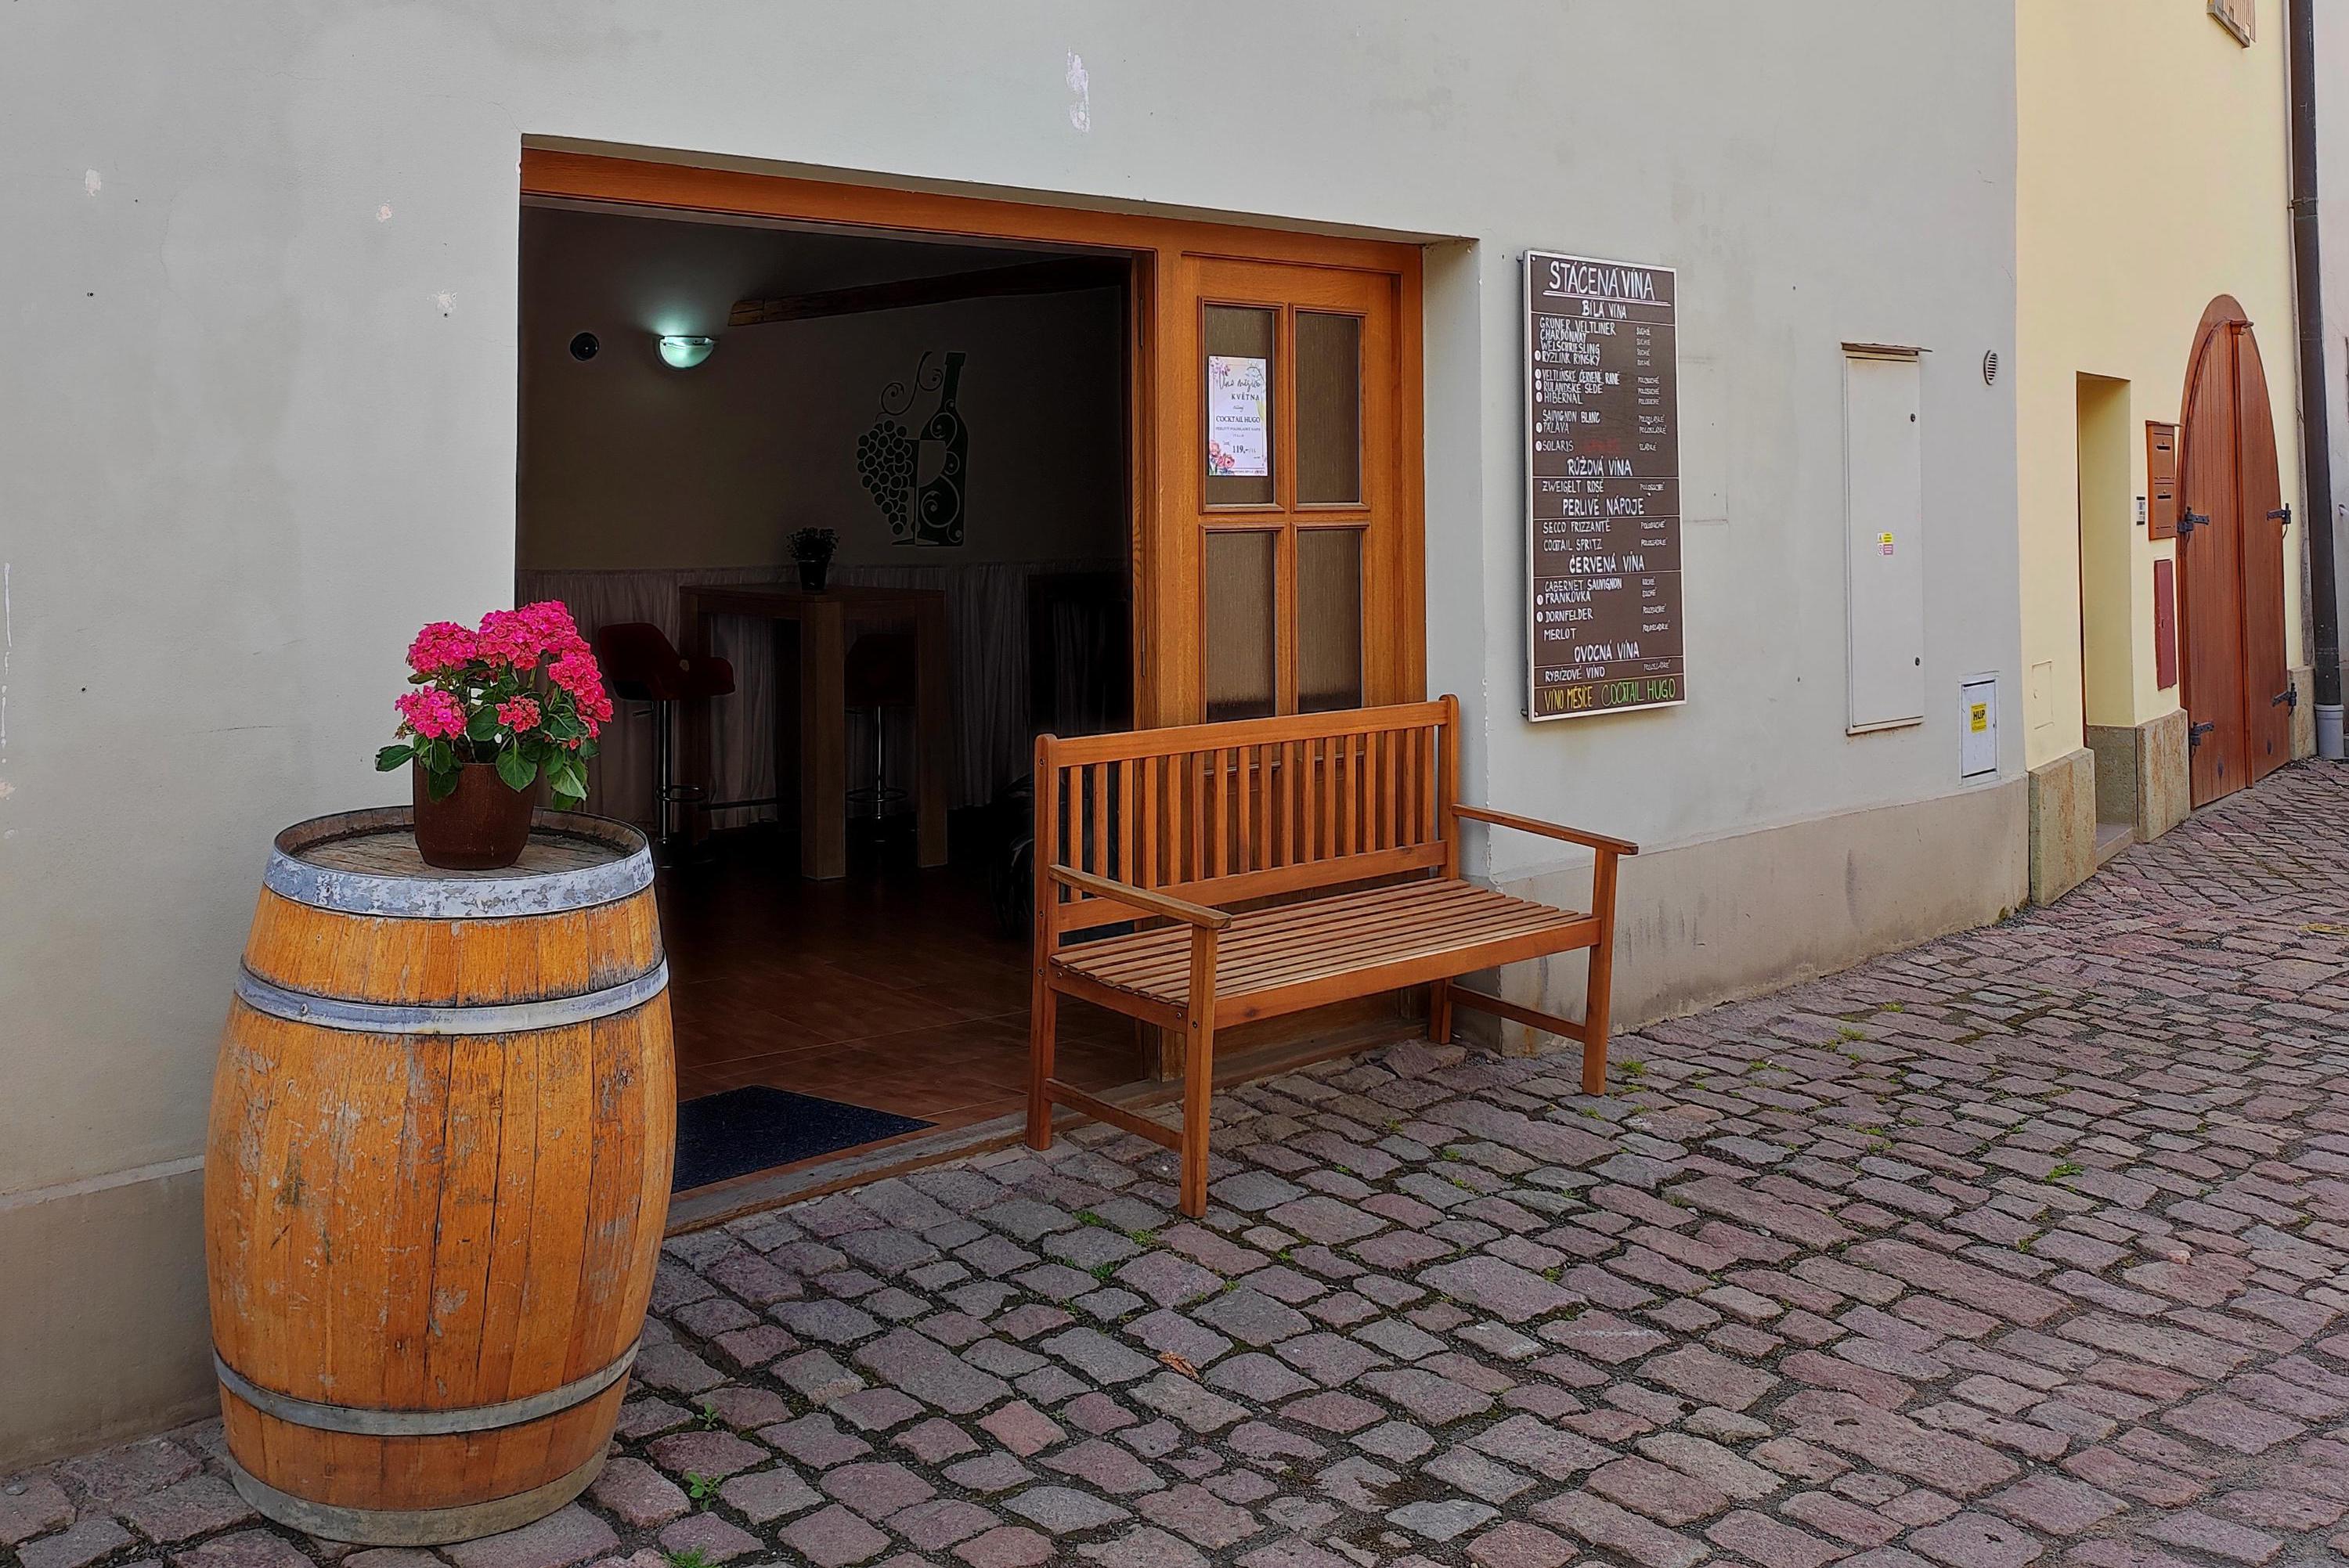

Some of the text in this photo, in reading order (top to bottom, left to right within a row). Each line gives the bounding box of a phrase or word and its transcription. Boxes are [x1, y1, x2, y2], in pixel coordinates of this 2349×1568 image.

[1549, 261, 1654, 300] STÁČENÁ VÍNA
[1575, 320, 1616, 336] VELTLINER
[1540, 329, 1586, 342] CHARDONNAY
[1540, 341, 1600, 355] WELSCHRIESLING
[1544, 392, 1583, 405] HIBERNAL
[1543, 409, 1577, 423] SAUVIGNON
[1580, 411, 1600, 424] BLANC
[1543, 440, 1574, 452] SOLARIS
[1608, 456, 1633, 476] VÍNA
[1542, 480, 1582, 494] ZWEIGELT
[1607, 496, 1644, 516] NÁPOJE
[1543, 521, 1566, 534] SECCO
[1575, 538, 1603, 551] SPRITZ
[1622, 550, 1645, 572] VÍNA
[1544, 579, 1584, 592] CABERNET
[1545, 590, 1591, 604] FRANKOVKA
[1545, 608, 1593, 623] DORNFELDER
[1544, 628, 1577, 641] MERLOT
[1574, 639, 1640, 662] OVOCNÁ VÍNA
[1586, 664, 1605, 679] VÍNO
[1647, 678, 1676, 701] HUGO
[1973, 709, 1985, 721] HUP
